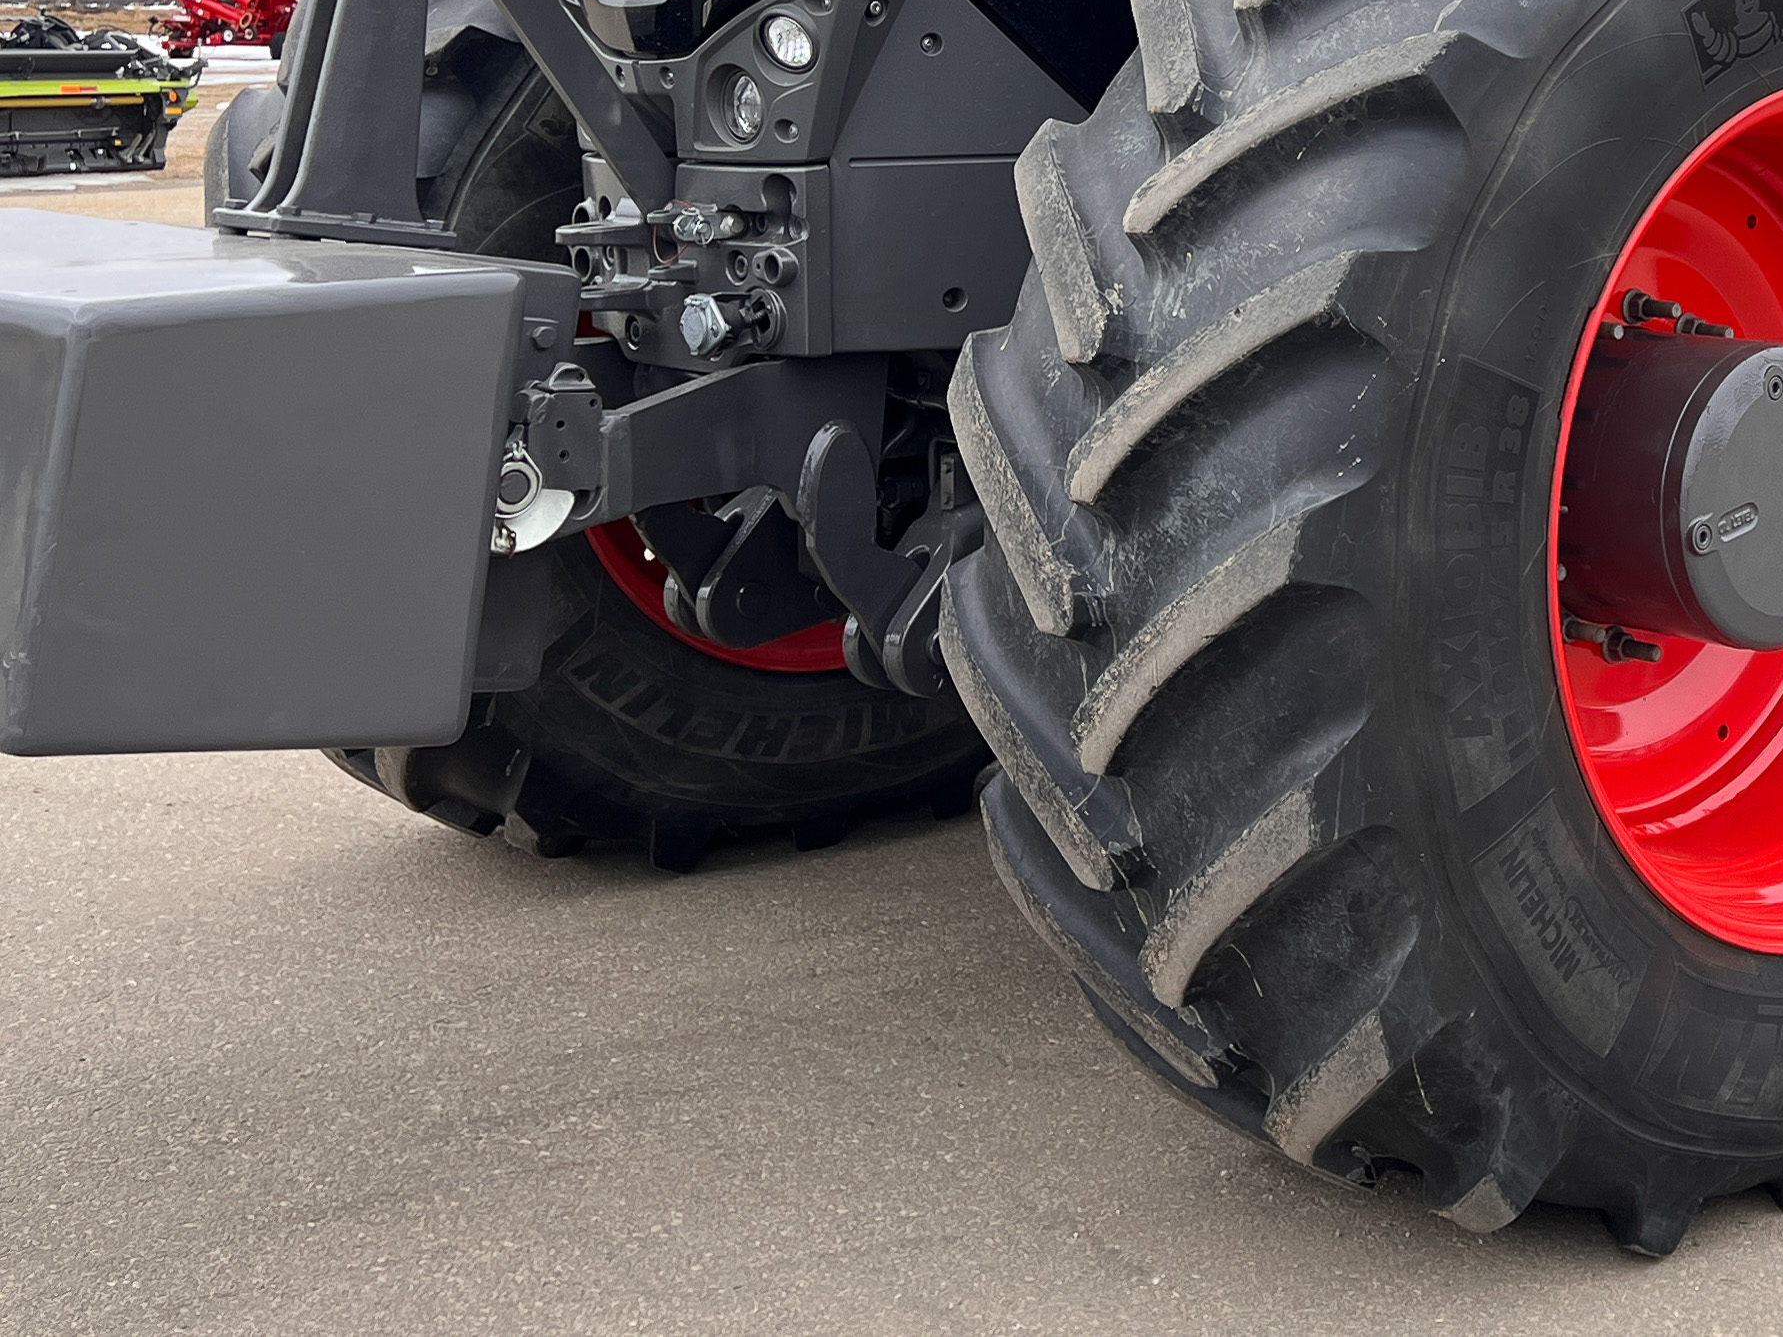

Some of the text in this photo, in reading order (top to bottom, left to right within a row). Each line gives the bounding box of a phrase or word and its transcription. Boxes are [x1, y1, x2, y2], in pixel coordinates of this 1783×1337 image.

[1500, 393, 1530, 455] 38
[1493, 470, 1516, 504] R
[1439, 423, 1494, 738] AXIOBIB
[568, 661, 928, 761] MICHELIN
[1500, 845, 1581, 984] MICHELIN
